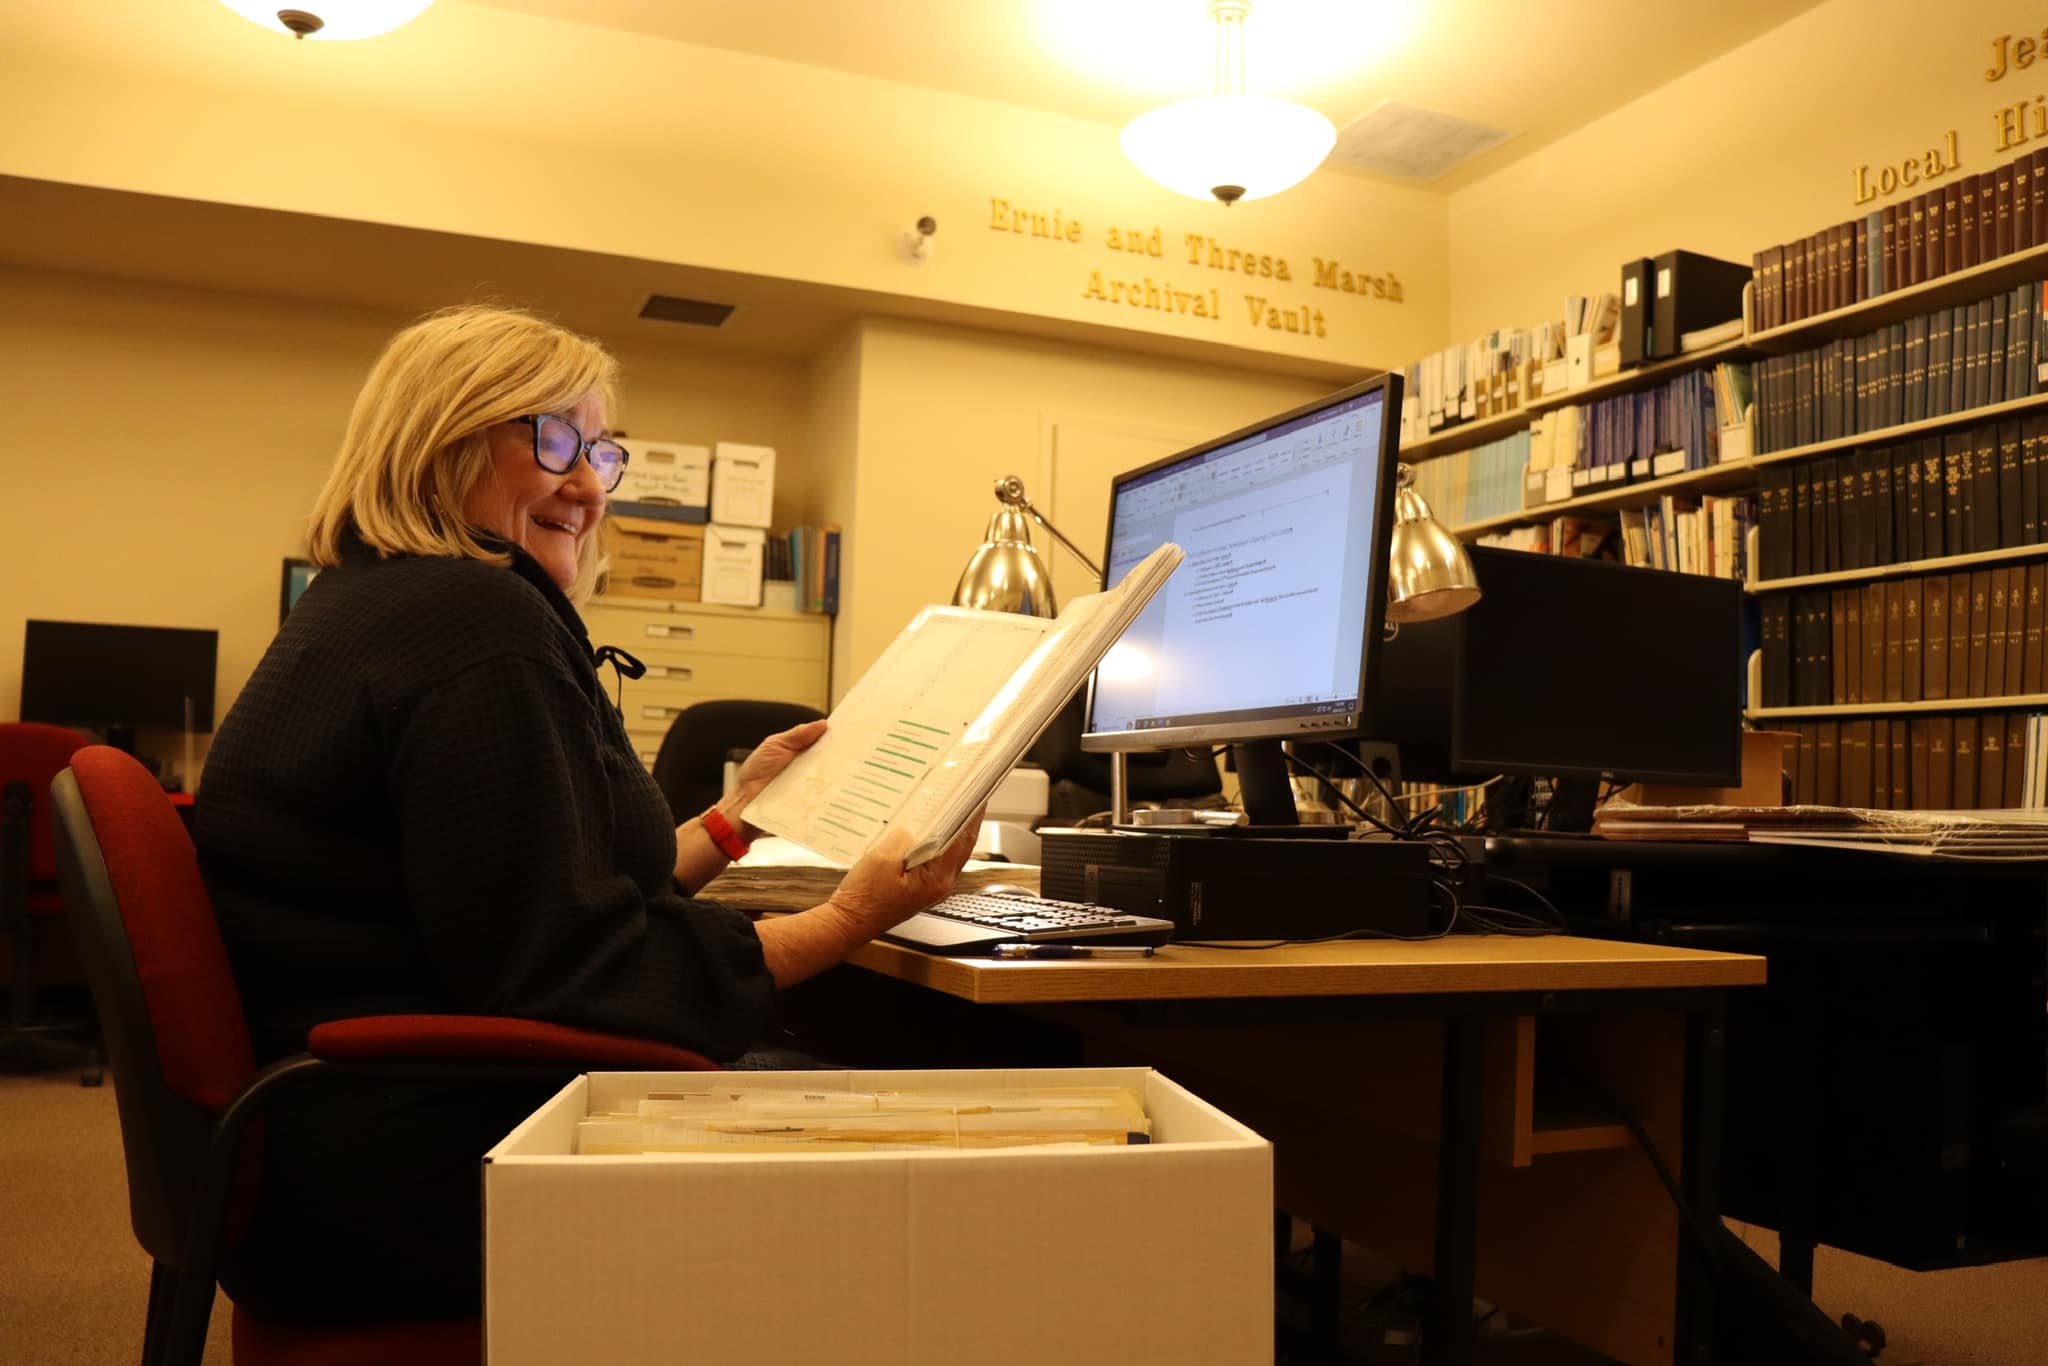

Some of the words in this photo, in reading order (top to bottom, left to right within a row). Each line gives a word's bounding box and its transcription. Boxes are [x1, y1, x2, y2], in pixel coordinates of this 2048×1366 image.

[1853, 130, 1961, 205] Local
[989, 197, 1082, 243] Ernie
[1107, 226, 1163, 258] and
[1184, 233, 1292, 282] Thresa
[1312, 257, 1405, 303] Marsh
[1082, 268, 1220, 321] Archival
[1244, 294, 1327, 338] Vault
